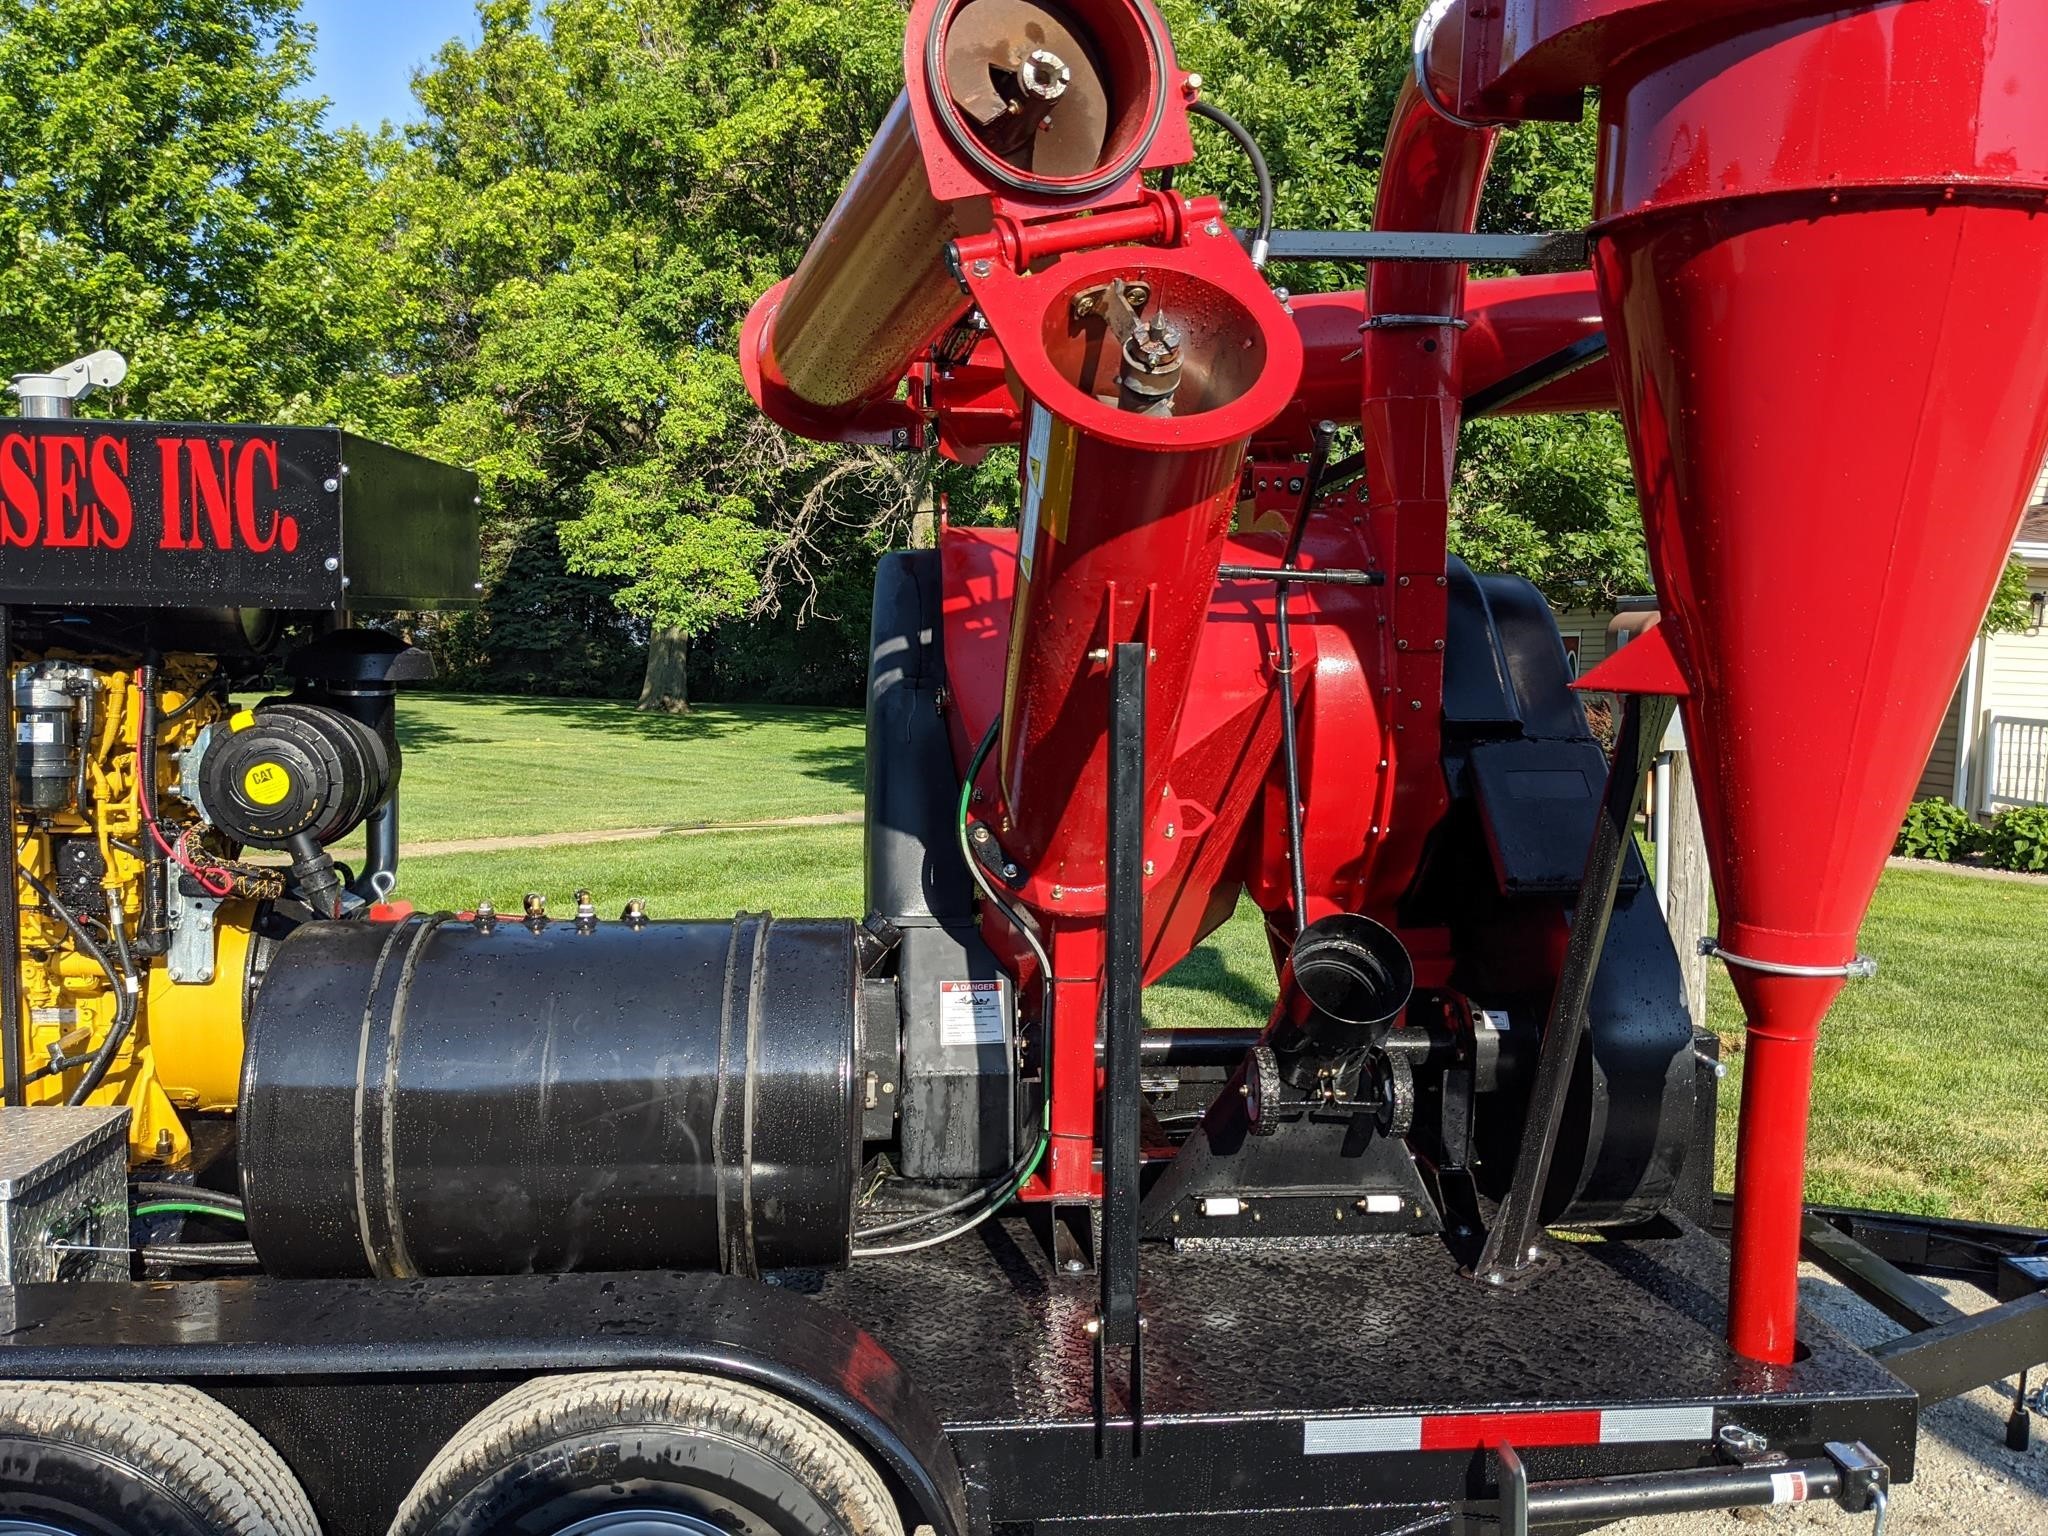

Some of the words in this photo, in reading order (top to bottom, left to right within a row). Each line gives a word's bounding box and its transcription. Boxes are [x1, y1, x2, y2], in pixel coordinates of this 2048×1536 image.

[0, 433, 132, 549] SES
[156, 438, 298, 552] INC.
[252, 768, 273, 784] CAT
[960, 983, 995, 991] DANGER
